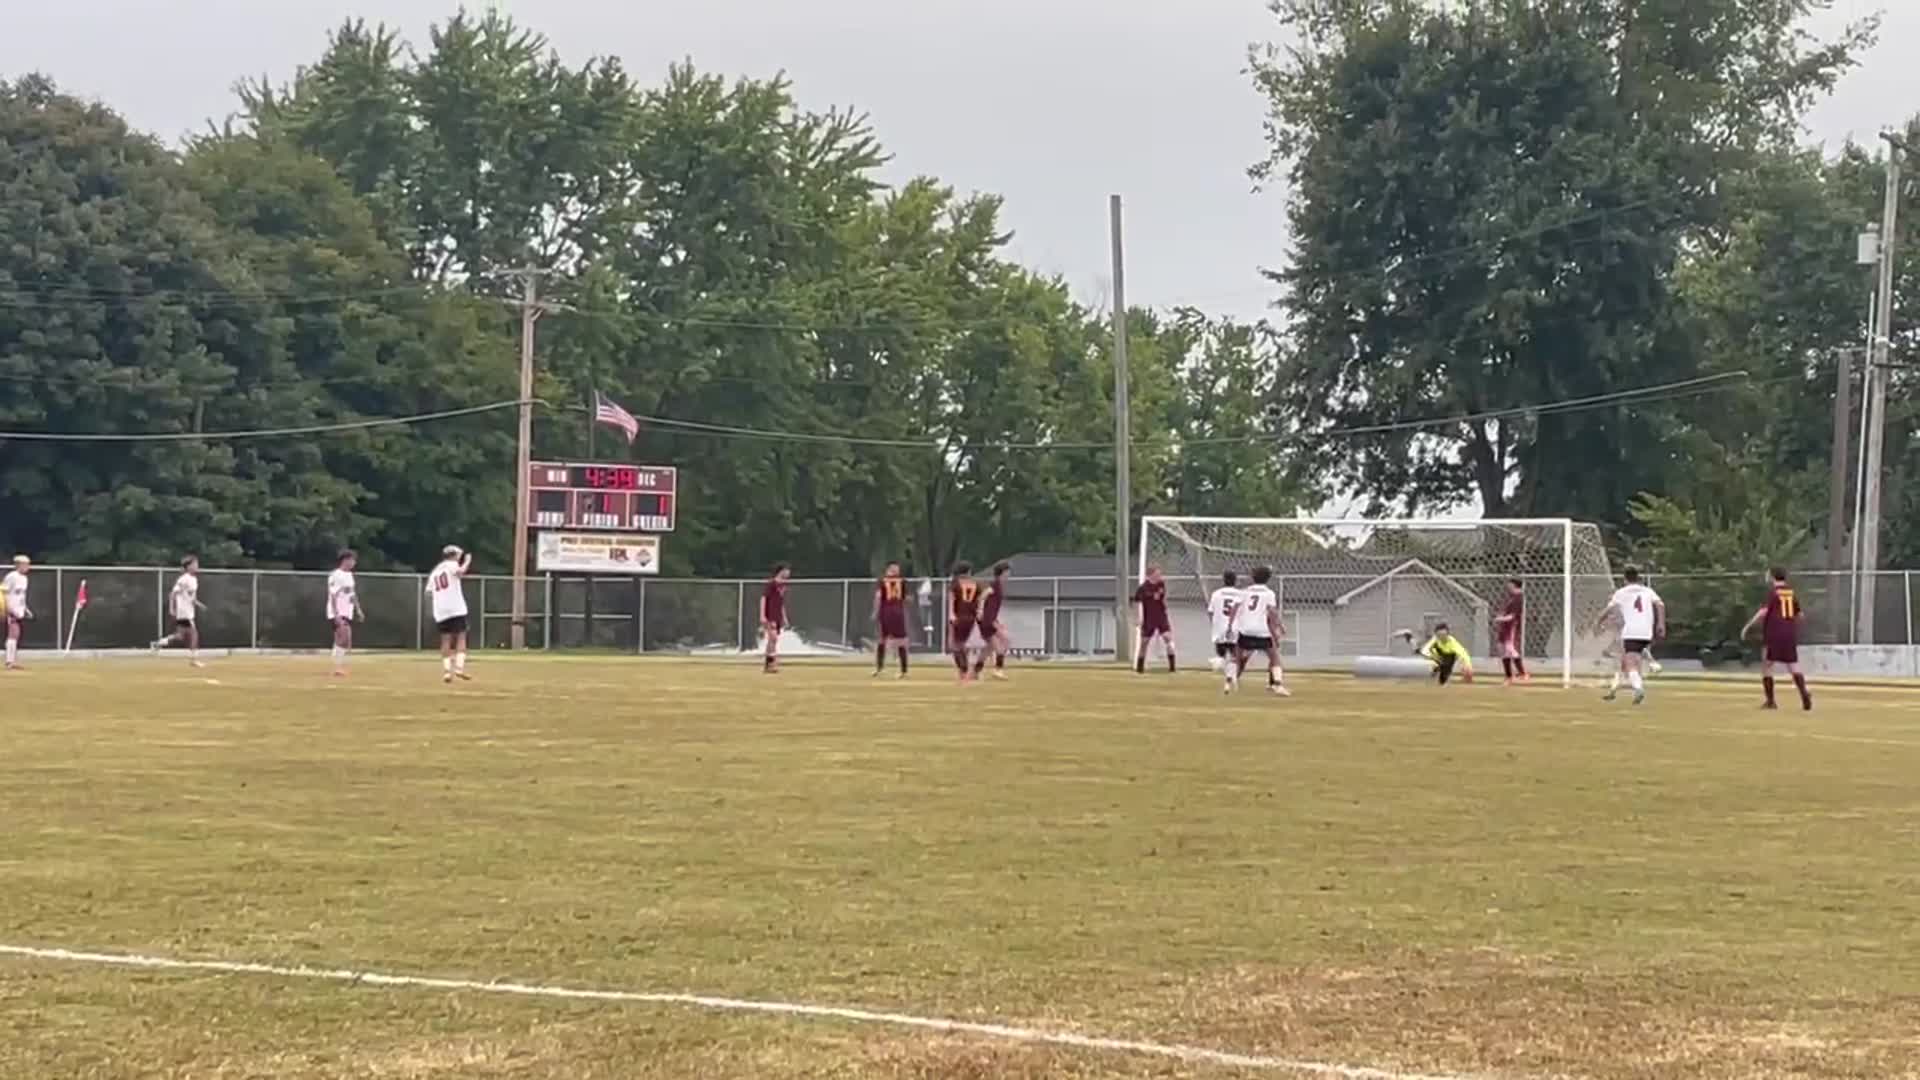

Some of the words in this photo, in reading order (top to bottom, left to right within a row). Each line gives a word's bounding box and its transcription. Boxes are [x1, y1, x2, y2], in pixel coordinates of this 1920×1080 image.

[547, 469, 567, 483] MIN
[585, 468, 634, 488] 4:39
[637, 472, 657, 487] SEC
[433, 571, 450, 592] 10
[960, 582, 977, 603] 17
[1223, 598, 1234, 616] 5
[1247, 595, 1260, 611] 3
[1633, 594, 1643, 613] 4
[1779, 596, 1794, 618] 11
